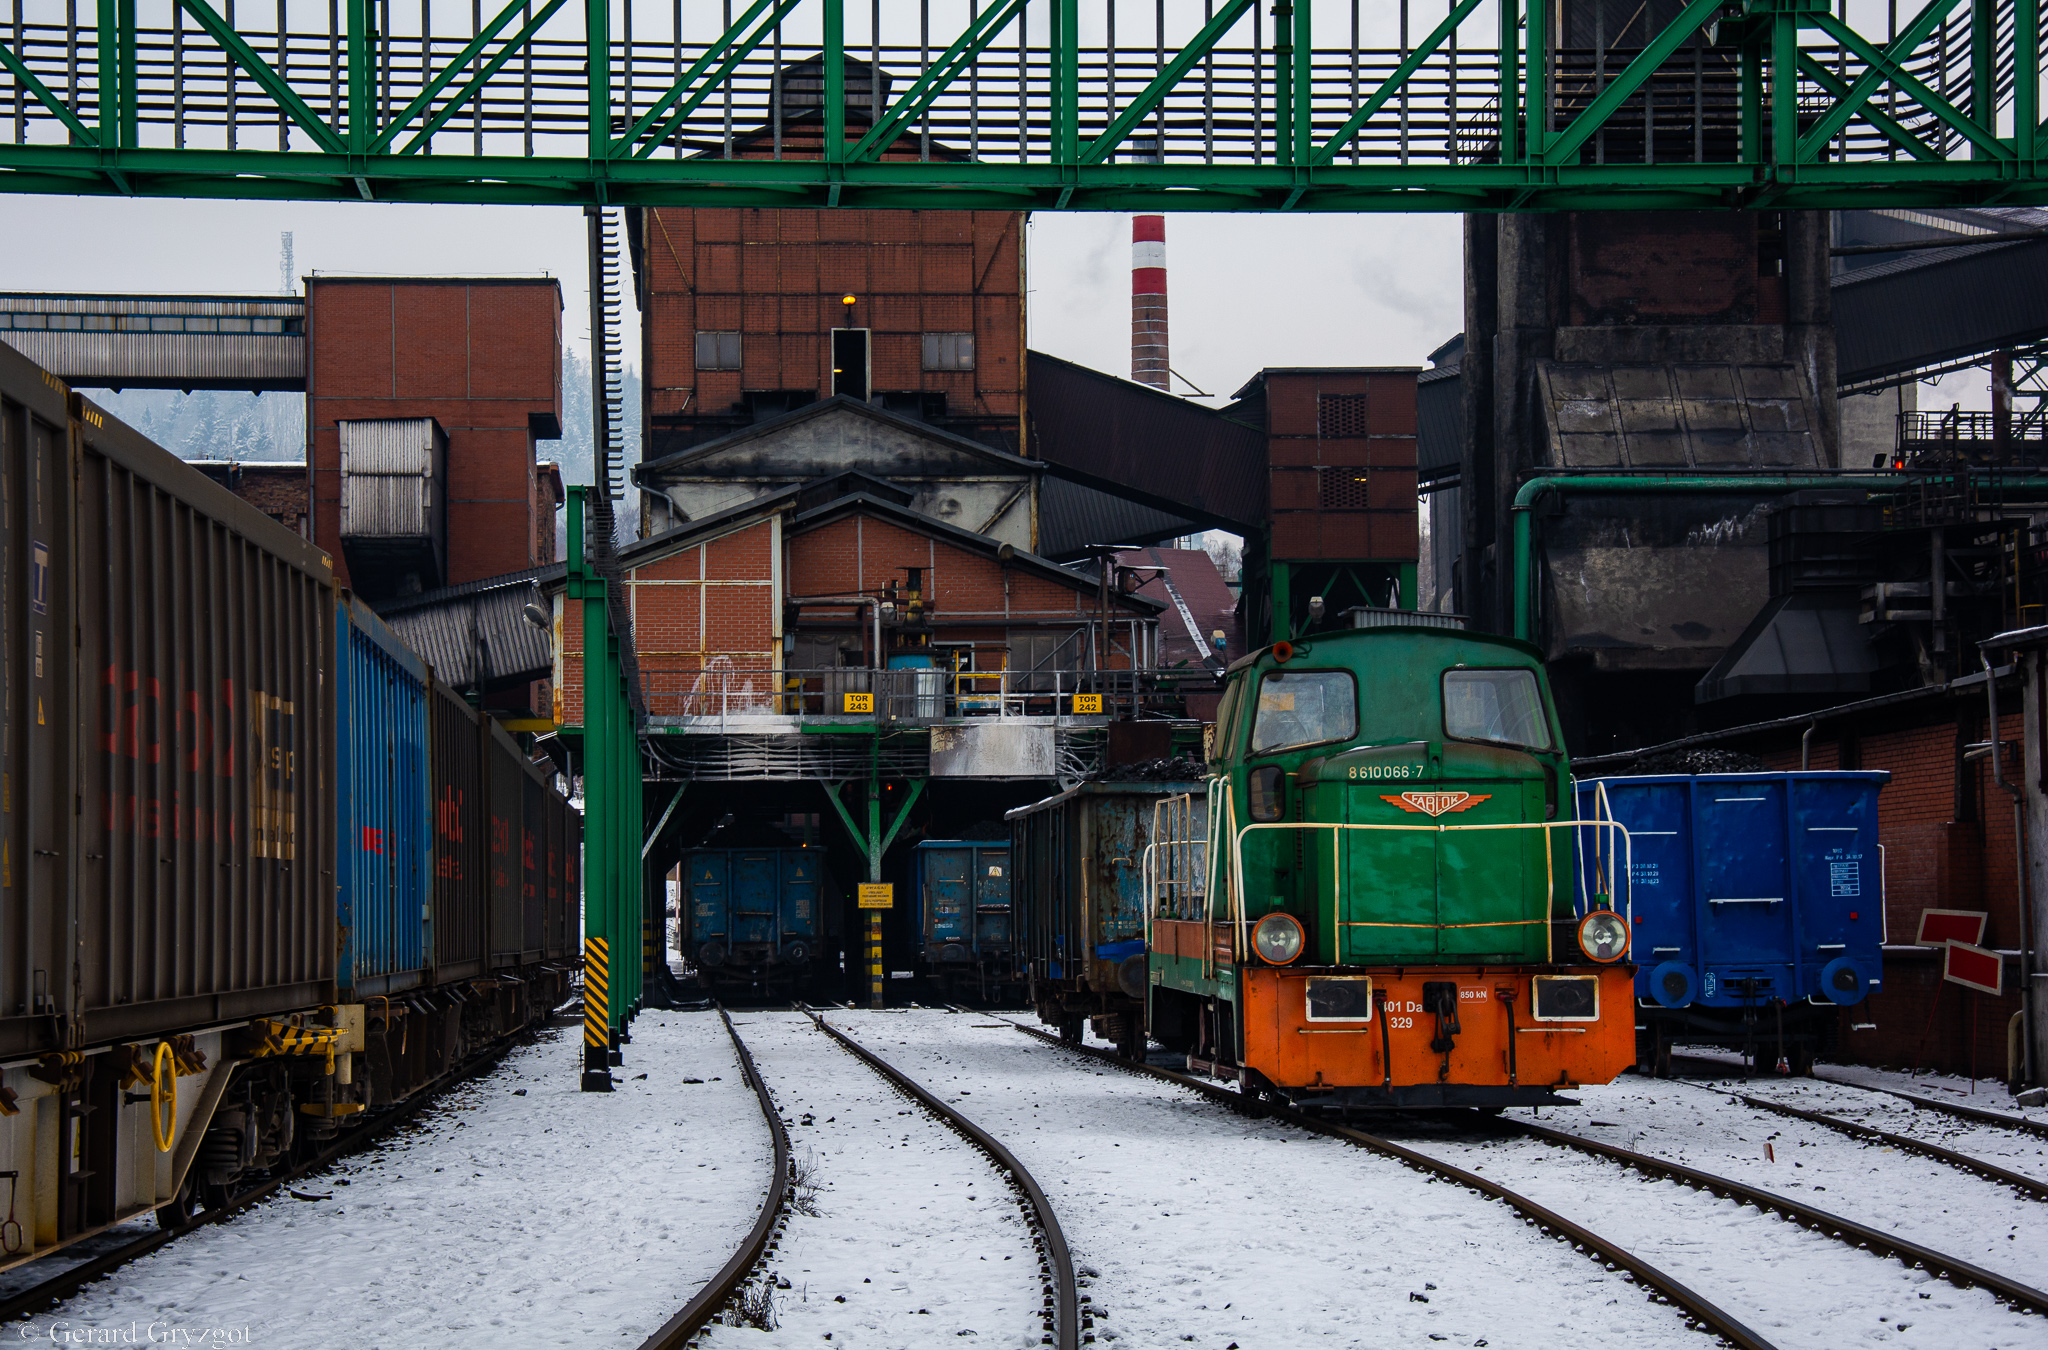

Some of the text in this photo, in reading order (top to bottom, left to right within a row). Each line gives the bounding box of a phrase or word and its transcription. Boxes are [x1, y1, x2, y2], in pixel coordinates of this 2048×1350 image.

[849, 694, 868, 702] TOR
[1078, 695, 1097, 703] TOR
[849, 702, 868, 711] 243
[1078, 703, 1097, 712] 242
[1411, 794, 1458, 813] FABLOK
[1460, 991, 1474, 999] 850
[1406, 1001, 1423, 1013] Da
[1390, 1017, 1413, 1029] 329
